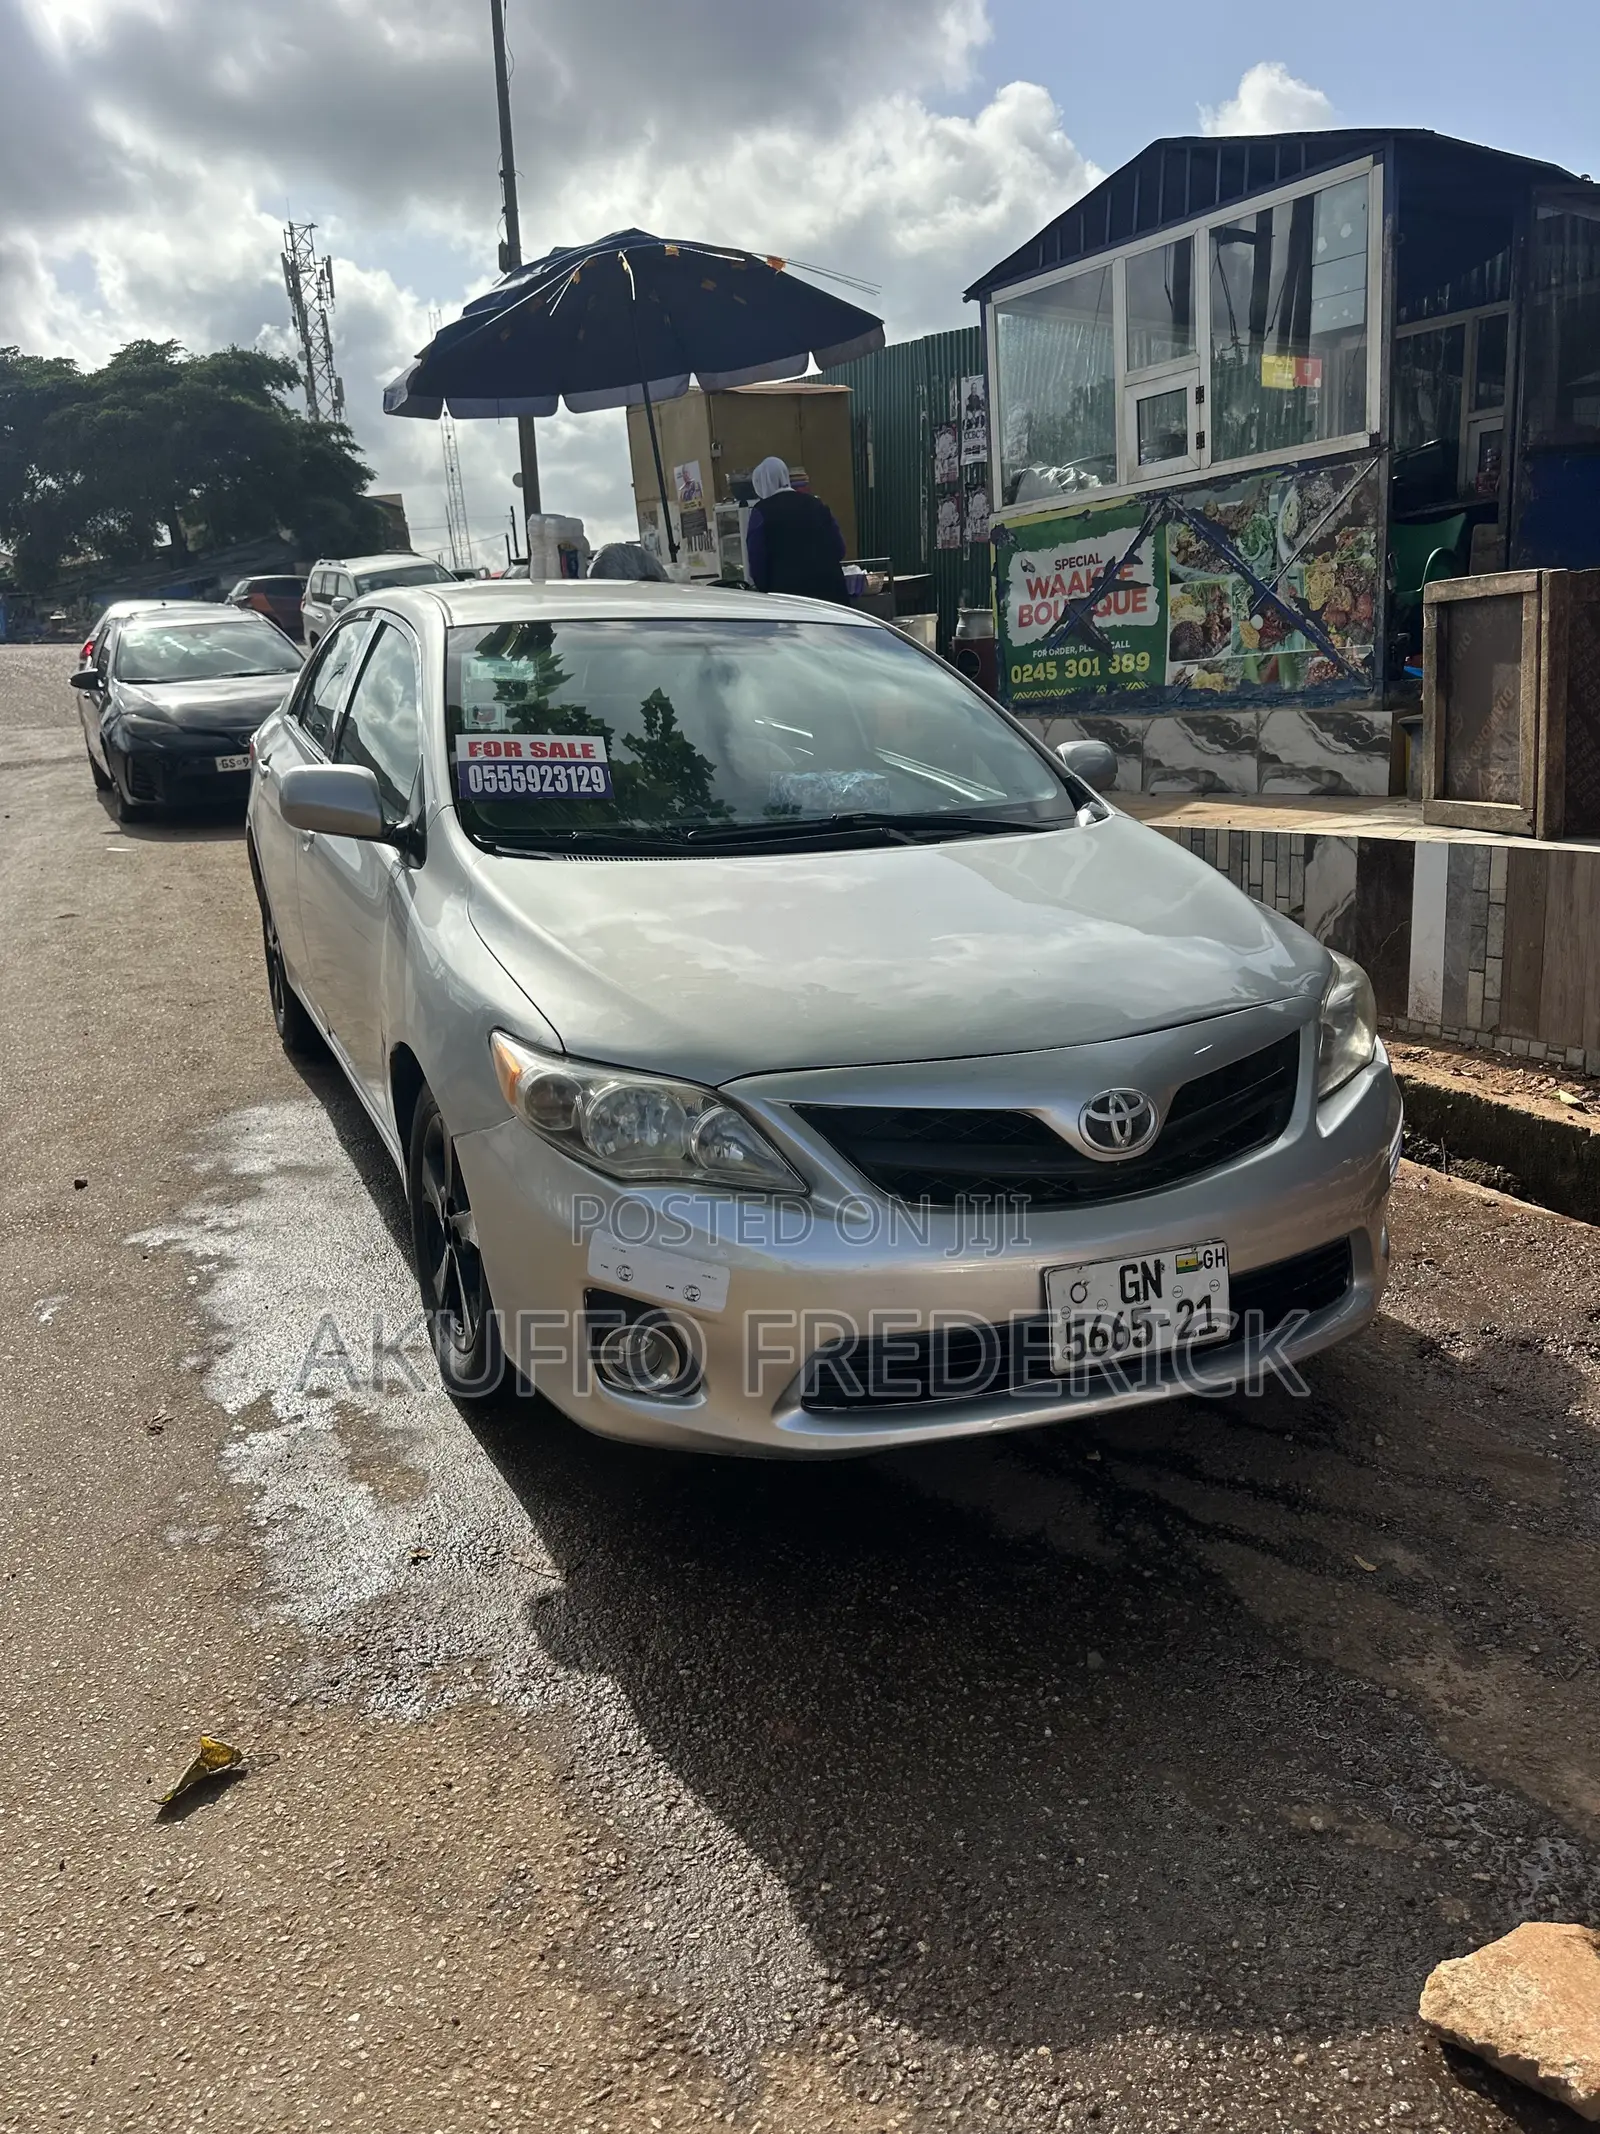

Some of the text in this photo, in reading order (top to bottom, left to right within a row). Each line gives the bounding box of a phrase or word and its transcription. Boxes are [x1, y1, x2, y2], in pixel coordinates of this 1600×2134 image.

[1054, 553, 1103, 571] SPECIAL
[1026, 564, 1134, 601] WAAKE
[1018, 588, 1148, 628] BOUQUE
[1011, 651, 1151, 684] 0245 301 389
[1032, 649, 1047, 659] FOR
[1048, 645, 1078, 657] ORDER,
[1469, 685, 1516, 761] DIAMOND
[221, 758, 236, 769] GS
[468, 741, 597, 759] FOR SALE
[468, 764, 607, 793] 0555923129
[1118, 1247, 1226, 1304] GN GH
[1065, 1294, 1219, 1362] 5665-21
